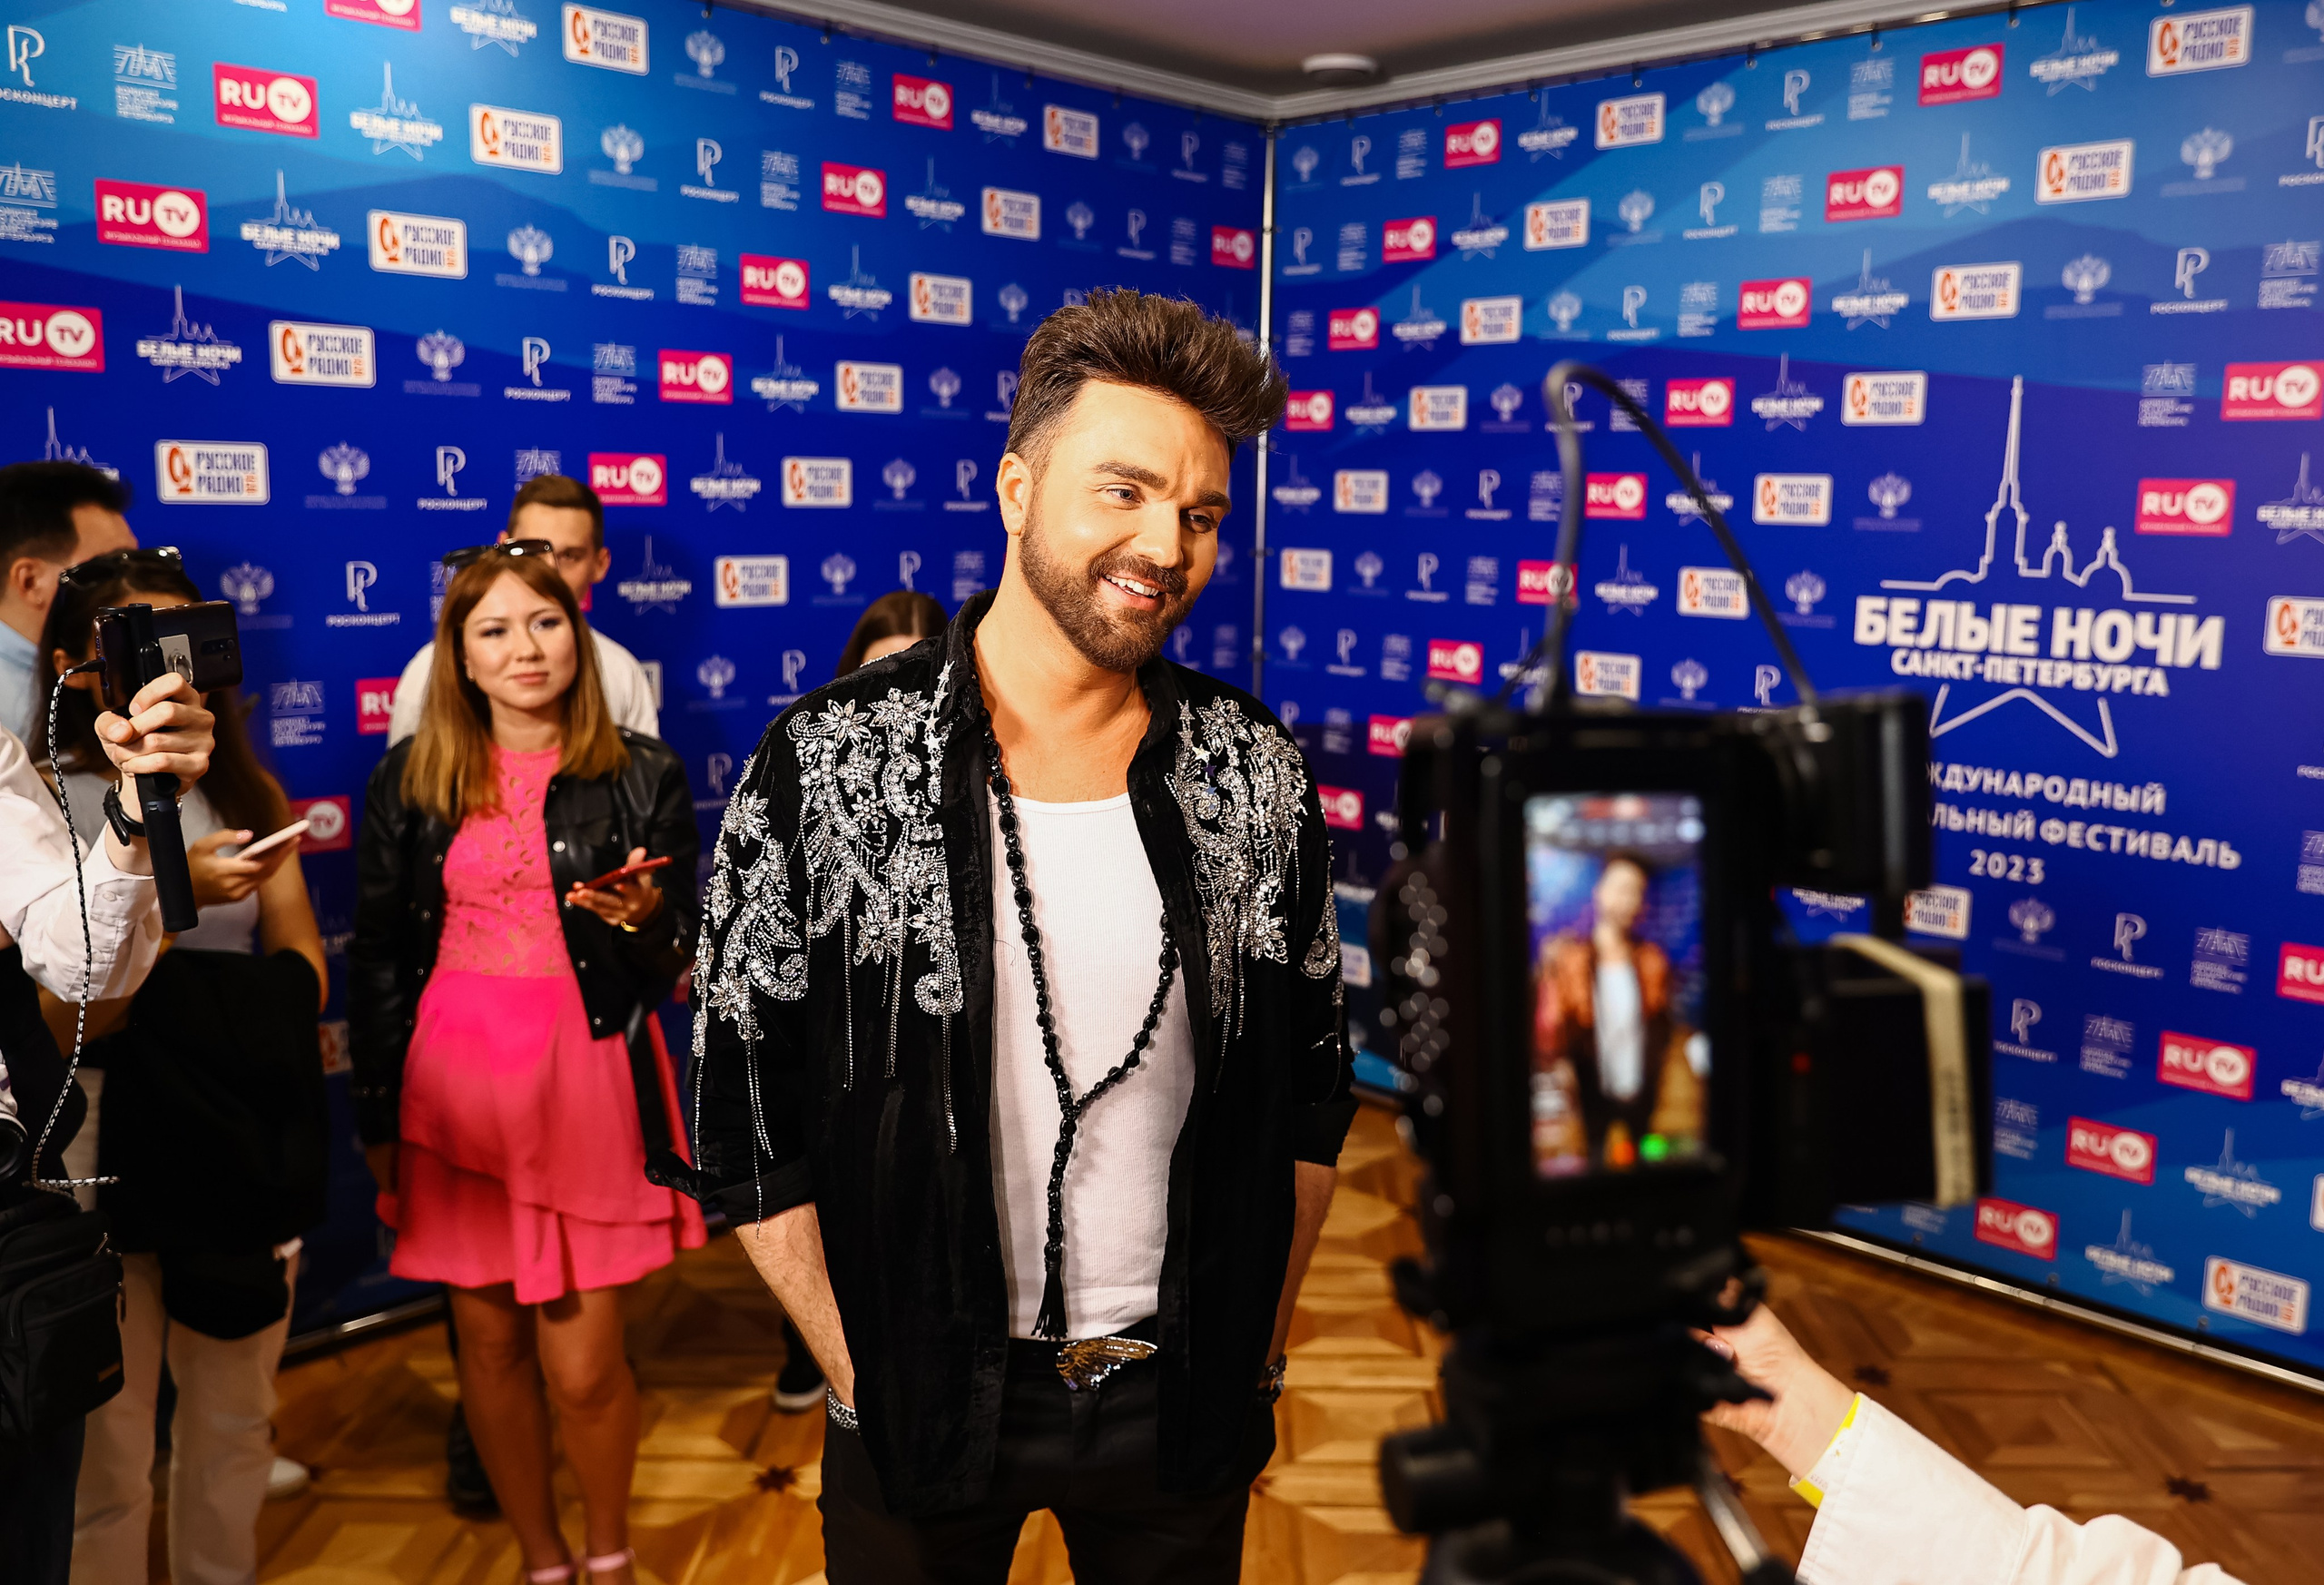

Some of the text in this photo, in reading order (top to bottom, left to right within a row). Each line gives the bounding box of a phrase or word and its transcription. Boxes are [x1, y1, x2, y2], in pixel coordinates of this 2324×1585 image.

[219, 76, 302, 111] RU TV
[102, 193, 190, 225] RU TV
[55, 326, 84, 344] TV
[664, 361, 696, 385] RU
[2228, 376, 2273, 399] RU
[594, 465, 629, 487] RU
[2142, 491, 2186, 515] RU
[1853, 596, 2225, 670] БЕЛЫЕ НОЧИ
[1890, 649, 2171, 697] САНКТ-ПЕТЕРБУРГА
[1928, 802, 2241, 871] ЛЬНЫЙ ФЕСТИВАЛЬ
[1968, 848, 2046, 885] 2023
